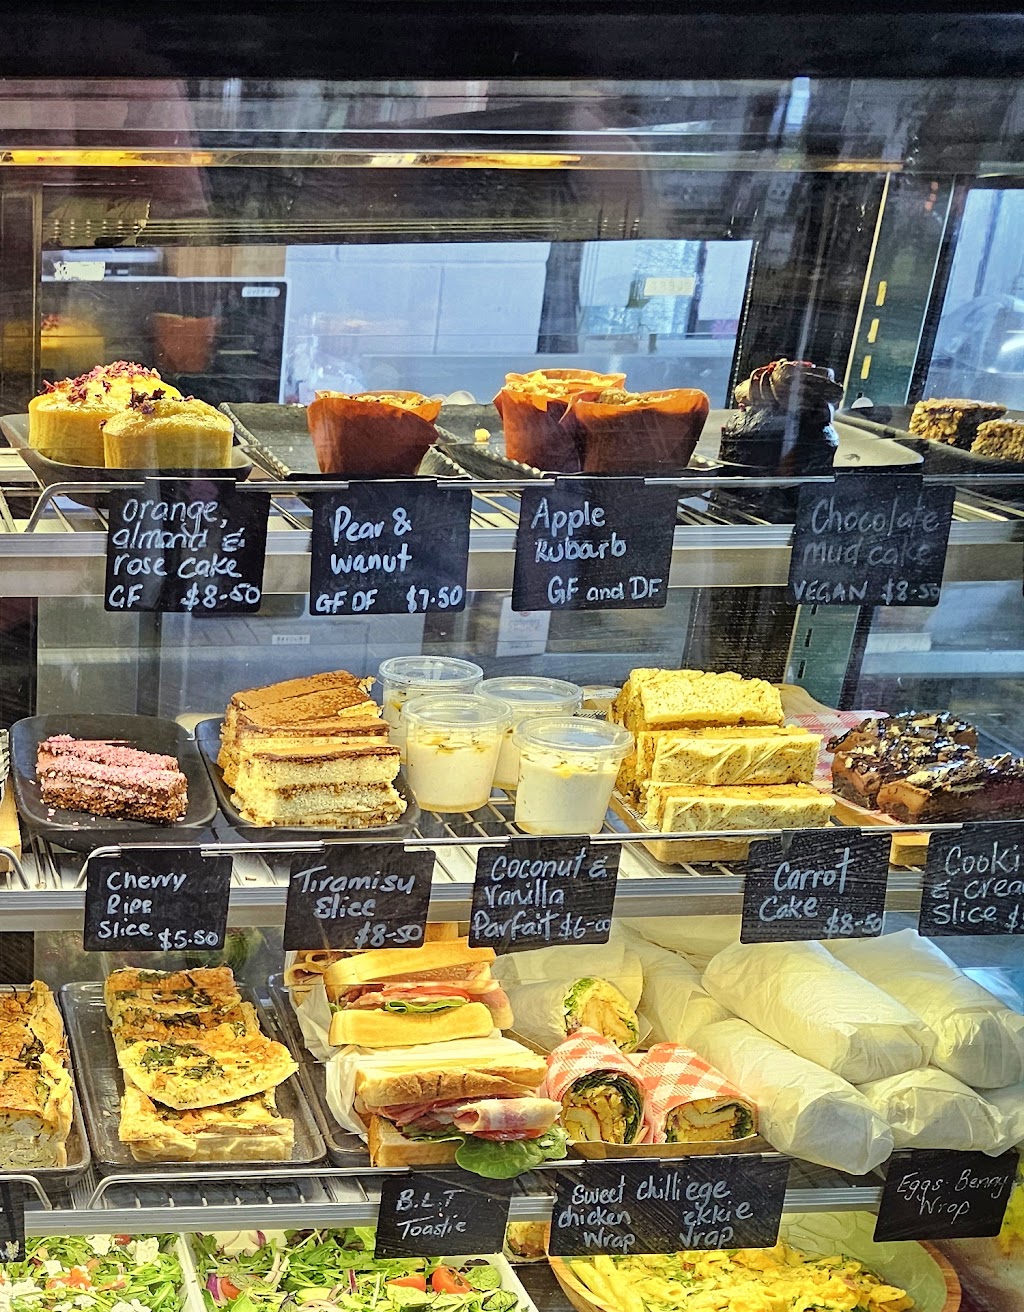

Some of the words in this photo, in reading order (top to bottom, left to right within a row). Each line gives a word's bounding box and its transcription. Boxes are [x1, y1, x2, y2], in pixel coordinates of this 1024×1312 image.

[333, 505, 385, 546] Pear
[392, 507, 412, 536] &
[530, 497, 606, 537] Apple
[811, 496, 940, 537] Chocolate
[112, 521, 208, 552] almond
[534, 532, 626, 563] Rubarb
[113, 553, 168, 576] rose
[108, 583, 144, 608] GF
[316, 590, 348, 614] GF
[352, 589, 378, 612] DF
[406, 584, 463, 614] $7.50
[547, 575, 579, 605] GF
[586, 581, 625, 602] and
[628, 575, 663, 601] DF
[793, 580, 869, 602] VEGAN
[491, 847, 586, 882] Coconut
[774, 847, 855, 894] Carrot
[107, 871, 187, 892] Cherry
[293, 865, 416, 895] Tiramisu
[484, 878, 565, 909] Vanilla
[964, 877, 1024, 899] crea
[759, 895, 818, 922] Cake
[158, 928, 219, 951] $5.50
[472, 910, 559, 941] Parfait
[571, 1175, 626, 1206] Sweet
[686, 1181, 730, 1211] ege
[955, 1169, 1009, 1199] Benny
[558, 1205, 632, 1229] chicken
[919, 1196, 970, 1224] Wrap
[397, 1214, 467, 1240] Toastie
[583, 1226, 636, 1254] Wrap
